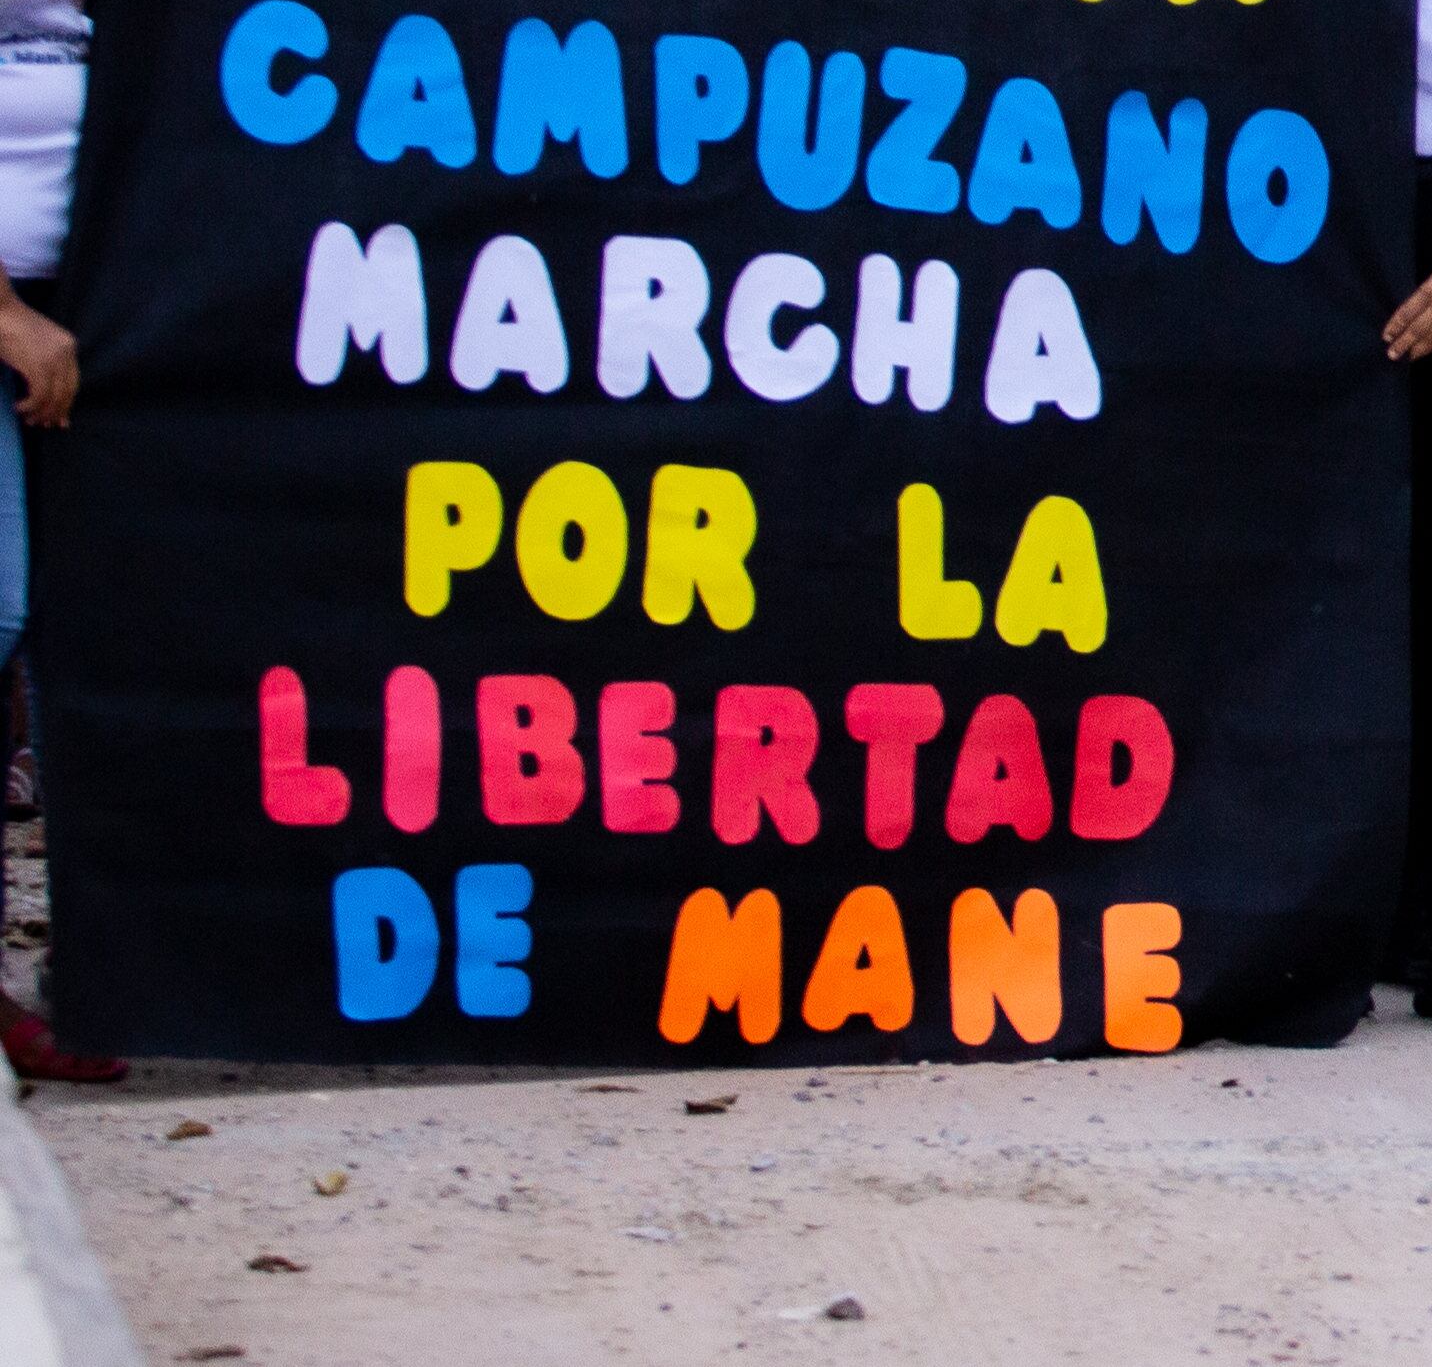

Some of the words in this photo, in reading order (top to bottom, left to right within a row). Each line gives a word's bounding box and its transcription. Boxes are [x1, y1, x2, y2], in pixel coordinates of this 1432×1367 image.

[296, 222, 1101, 424] MARCHA
[405, 461, 756, 630] POR
[898, 484, 1107, 653] LA
[260, 666, 1173, 849] LIBERTAD
[333, 864, 532, 1021] DE
[659, 886, 1182, 1052] MANE
